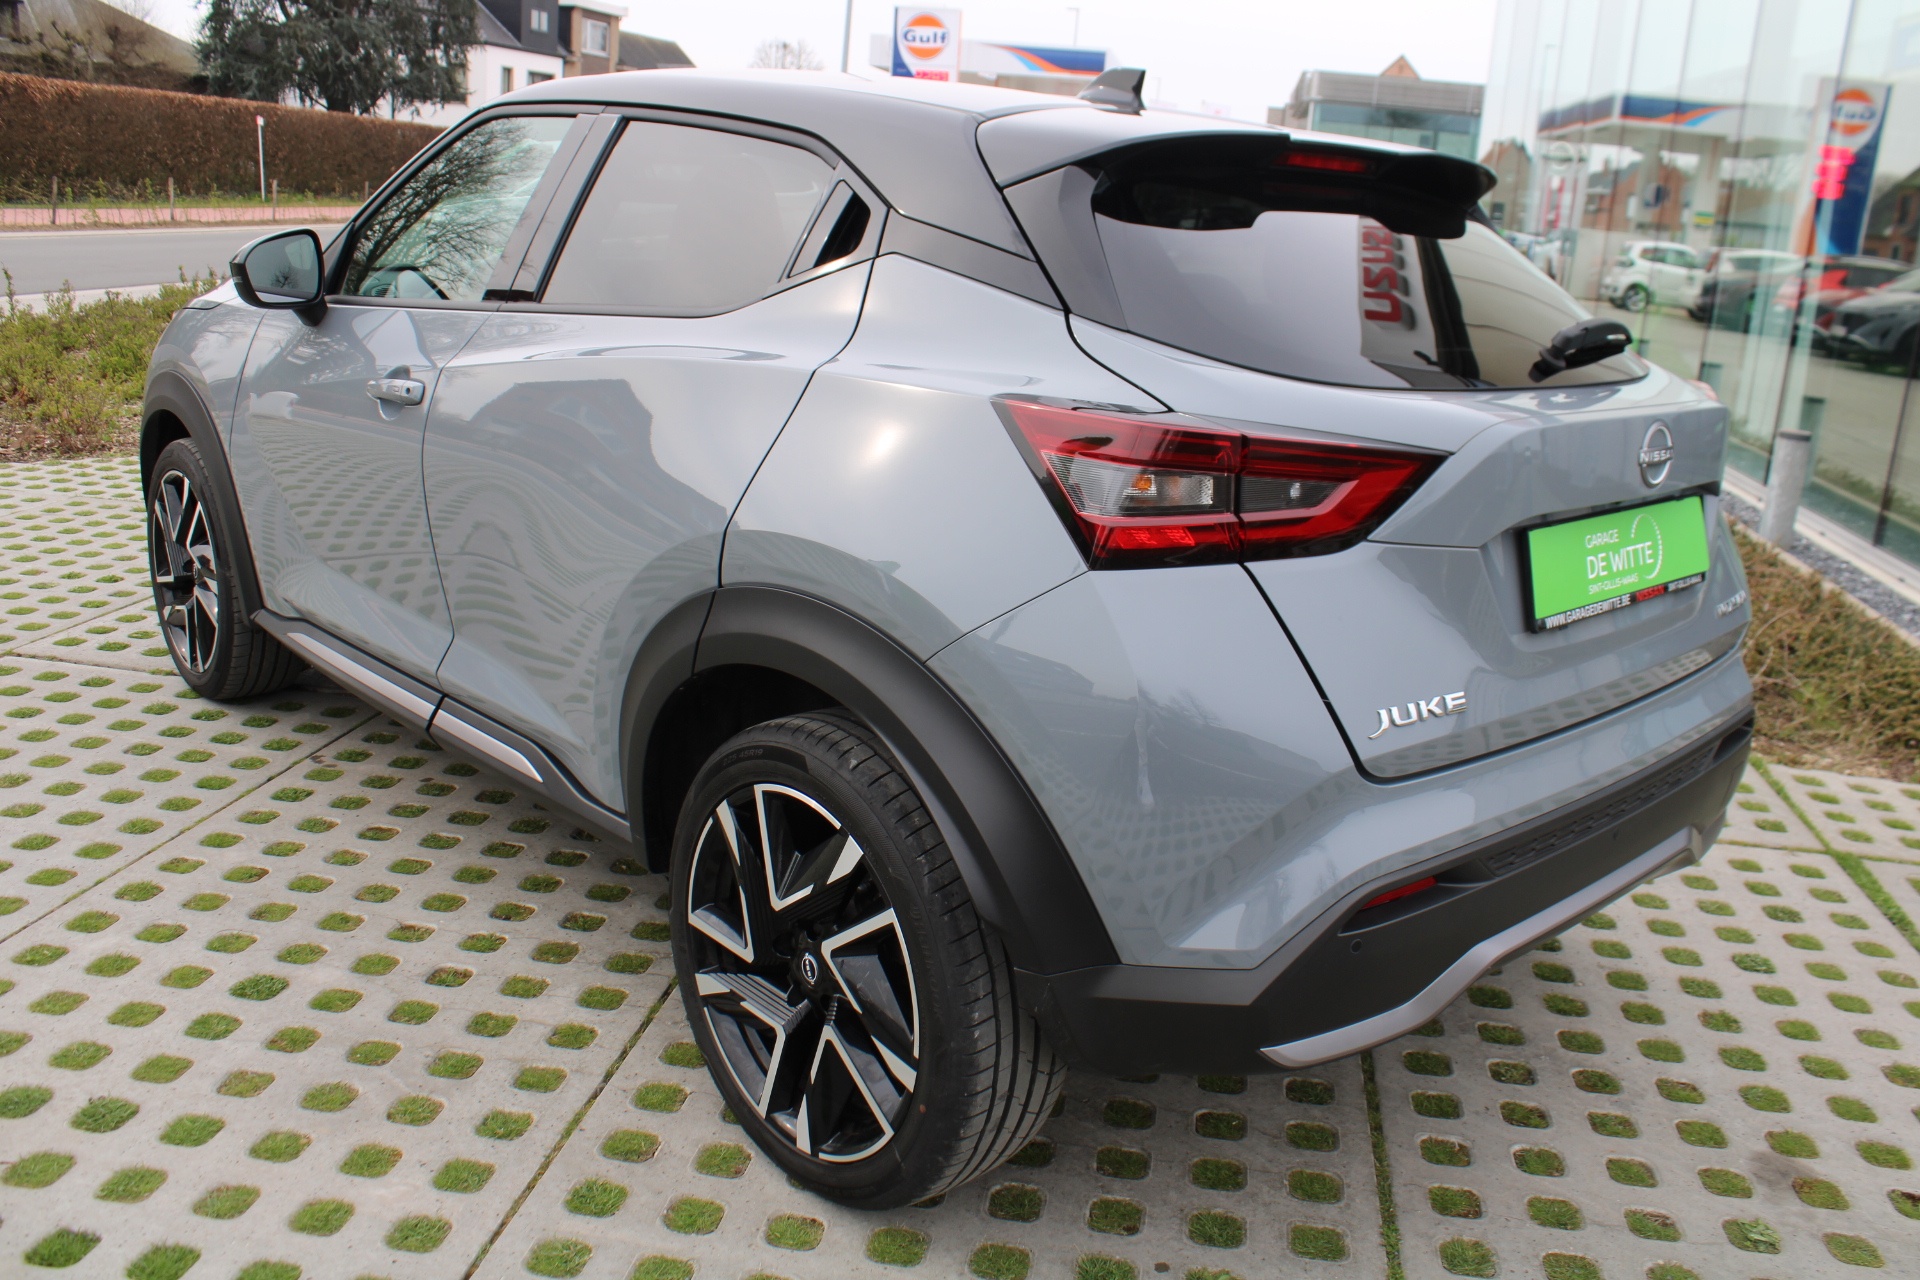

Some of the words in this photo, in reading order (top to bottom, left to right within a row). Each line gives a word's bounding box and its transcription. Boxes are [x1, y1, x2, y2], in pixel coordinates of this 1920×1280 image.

[903, 29, 948, 43] Gulf
[1585, 529, 1619, 548] GARAGE
[1587, 552, 1608, 578] DE
[1609, 541, 1654, 572] WITTE
[1367, 691, 1467, 739] JUKE
